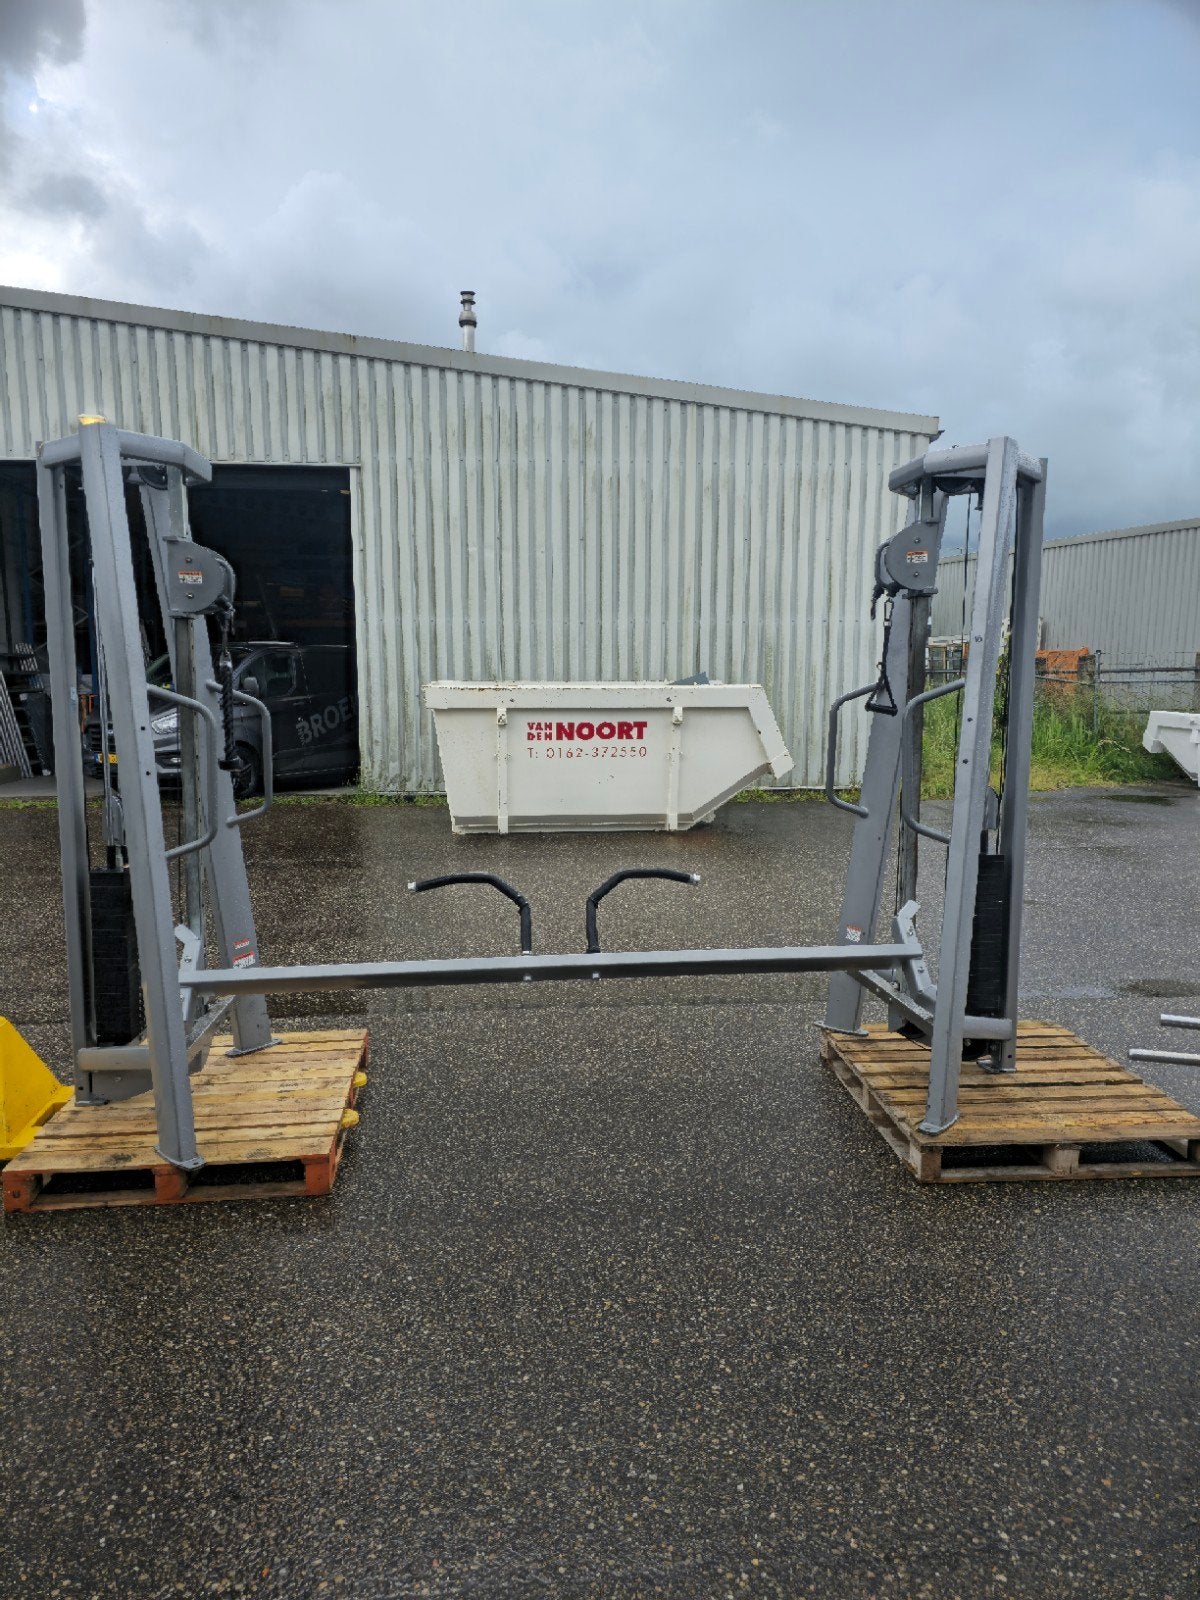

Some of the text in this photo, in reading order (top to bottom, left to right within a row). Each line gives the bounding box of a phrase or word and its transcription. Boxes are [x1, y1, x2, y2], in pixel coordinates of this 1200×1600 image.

[526, 722, 553, 731] VAN
[555, 721, 648, 741] NOORT
[526, 732, 553, 741] DEN
[527, 746, 647, 759] T: 0162-372550
